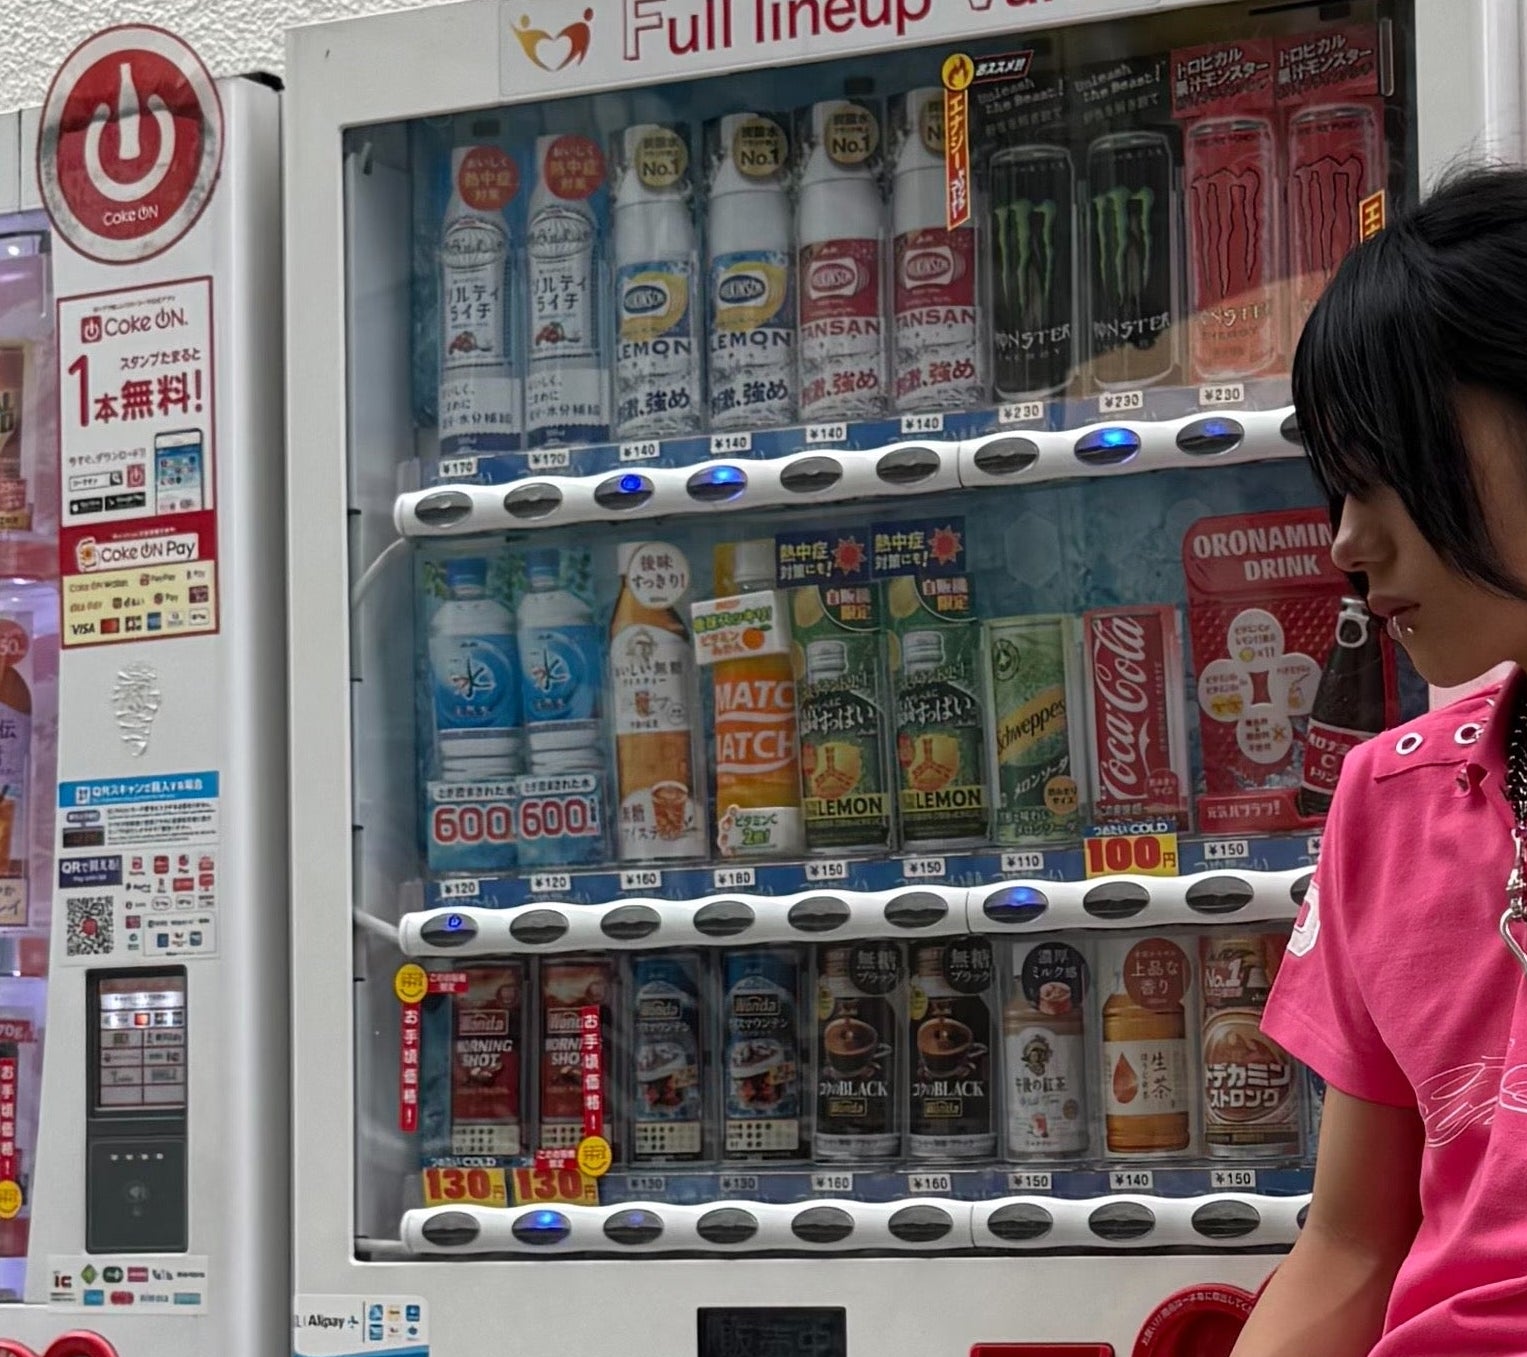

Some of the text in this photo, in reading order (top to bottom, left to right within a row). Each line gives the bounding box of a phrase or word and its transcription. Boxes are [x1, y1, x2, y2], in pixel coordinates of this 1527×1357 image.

[624, 0, 931, 61] Full lineup
[832, 135, 873, 155] No.1
[740, 147, 780, 167] No.1
[642, 158, 680, 177] No.1
[103, 209, 137, 227] Coke
[105, 315, 150, 337] Coke
[120, 348, 202, 370] スタンプたまると
[68, 354, 203, 428] 1本無料!
[1003, 404, 1039, 420] ¥230
[904, 416, 940, 431] ¥140
[809, 426, 844, 440] ¥140
[623, 443, 656, 458] ¥140
[713, 436, 748, 450] ¥140
[101, 544, 138, 563] Coke
[166, 540, 196, 560] Pay
[1243, 554, 1322, 581] DRINK
[69, 622, 96, 636] VISA
[1013, 755, 1069, 798] メロンソーダ
[818, 796, 883, 816] LEMON
[915, 788, 982, 809] LEMON
[434, 804, 514, 844] 600
[520, 797, 589, 838] 600
[1087, 836, 1177, 874] 100円
[1207, 843, 1245, 857] ¥150
[809, 863, 844, 877] ¥150
[908, 860, 942, 873] ¥150
[1006, 855, 1040, 867] ¥110
[442, 881, 477, 895] ¥120
[534, 875, 567, 888] ¥120
[1210, 1087, 1280, 1109] ストロング
[426, 1169, 506, 1201] 130円
[913, 1177, 949, 1190] ¥160
[1012, 1175, 1049, 1187] ¥150
[1114, 1174, 1149, 1187] ¥140
[1214, 1173, 1252, 1185] ¥150
